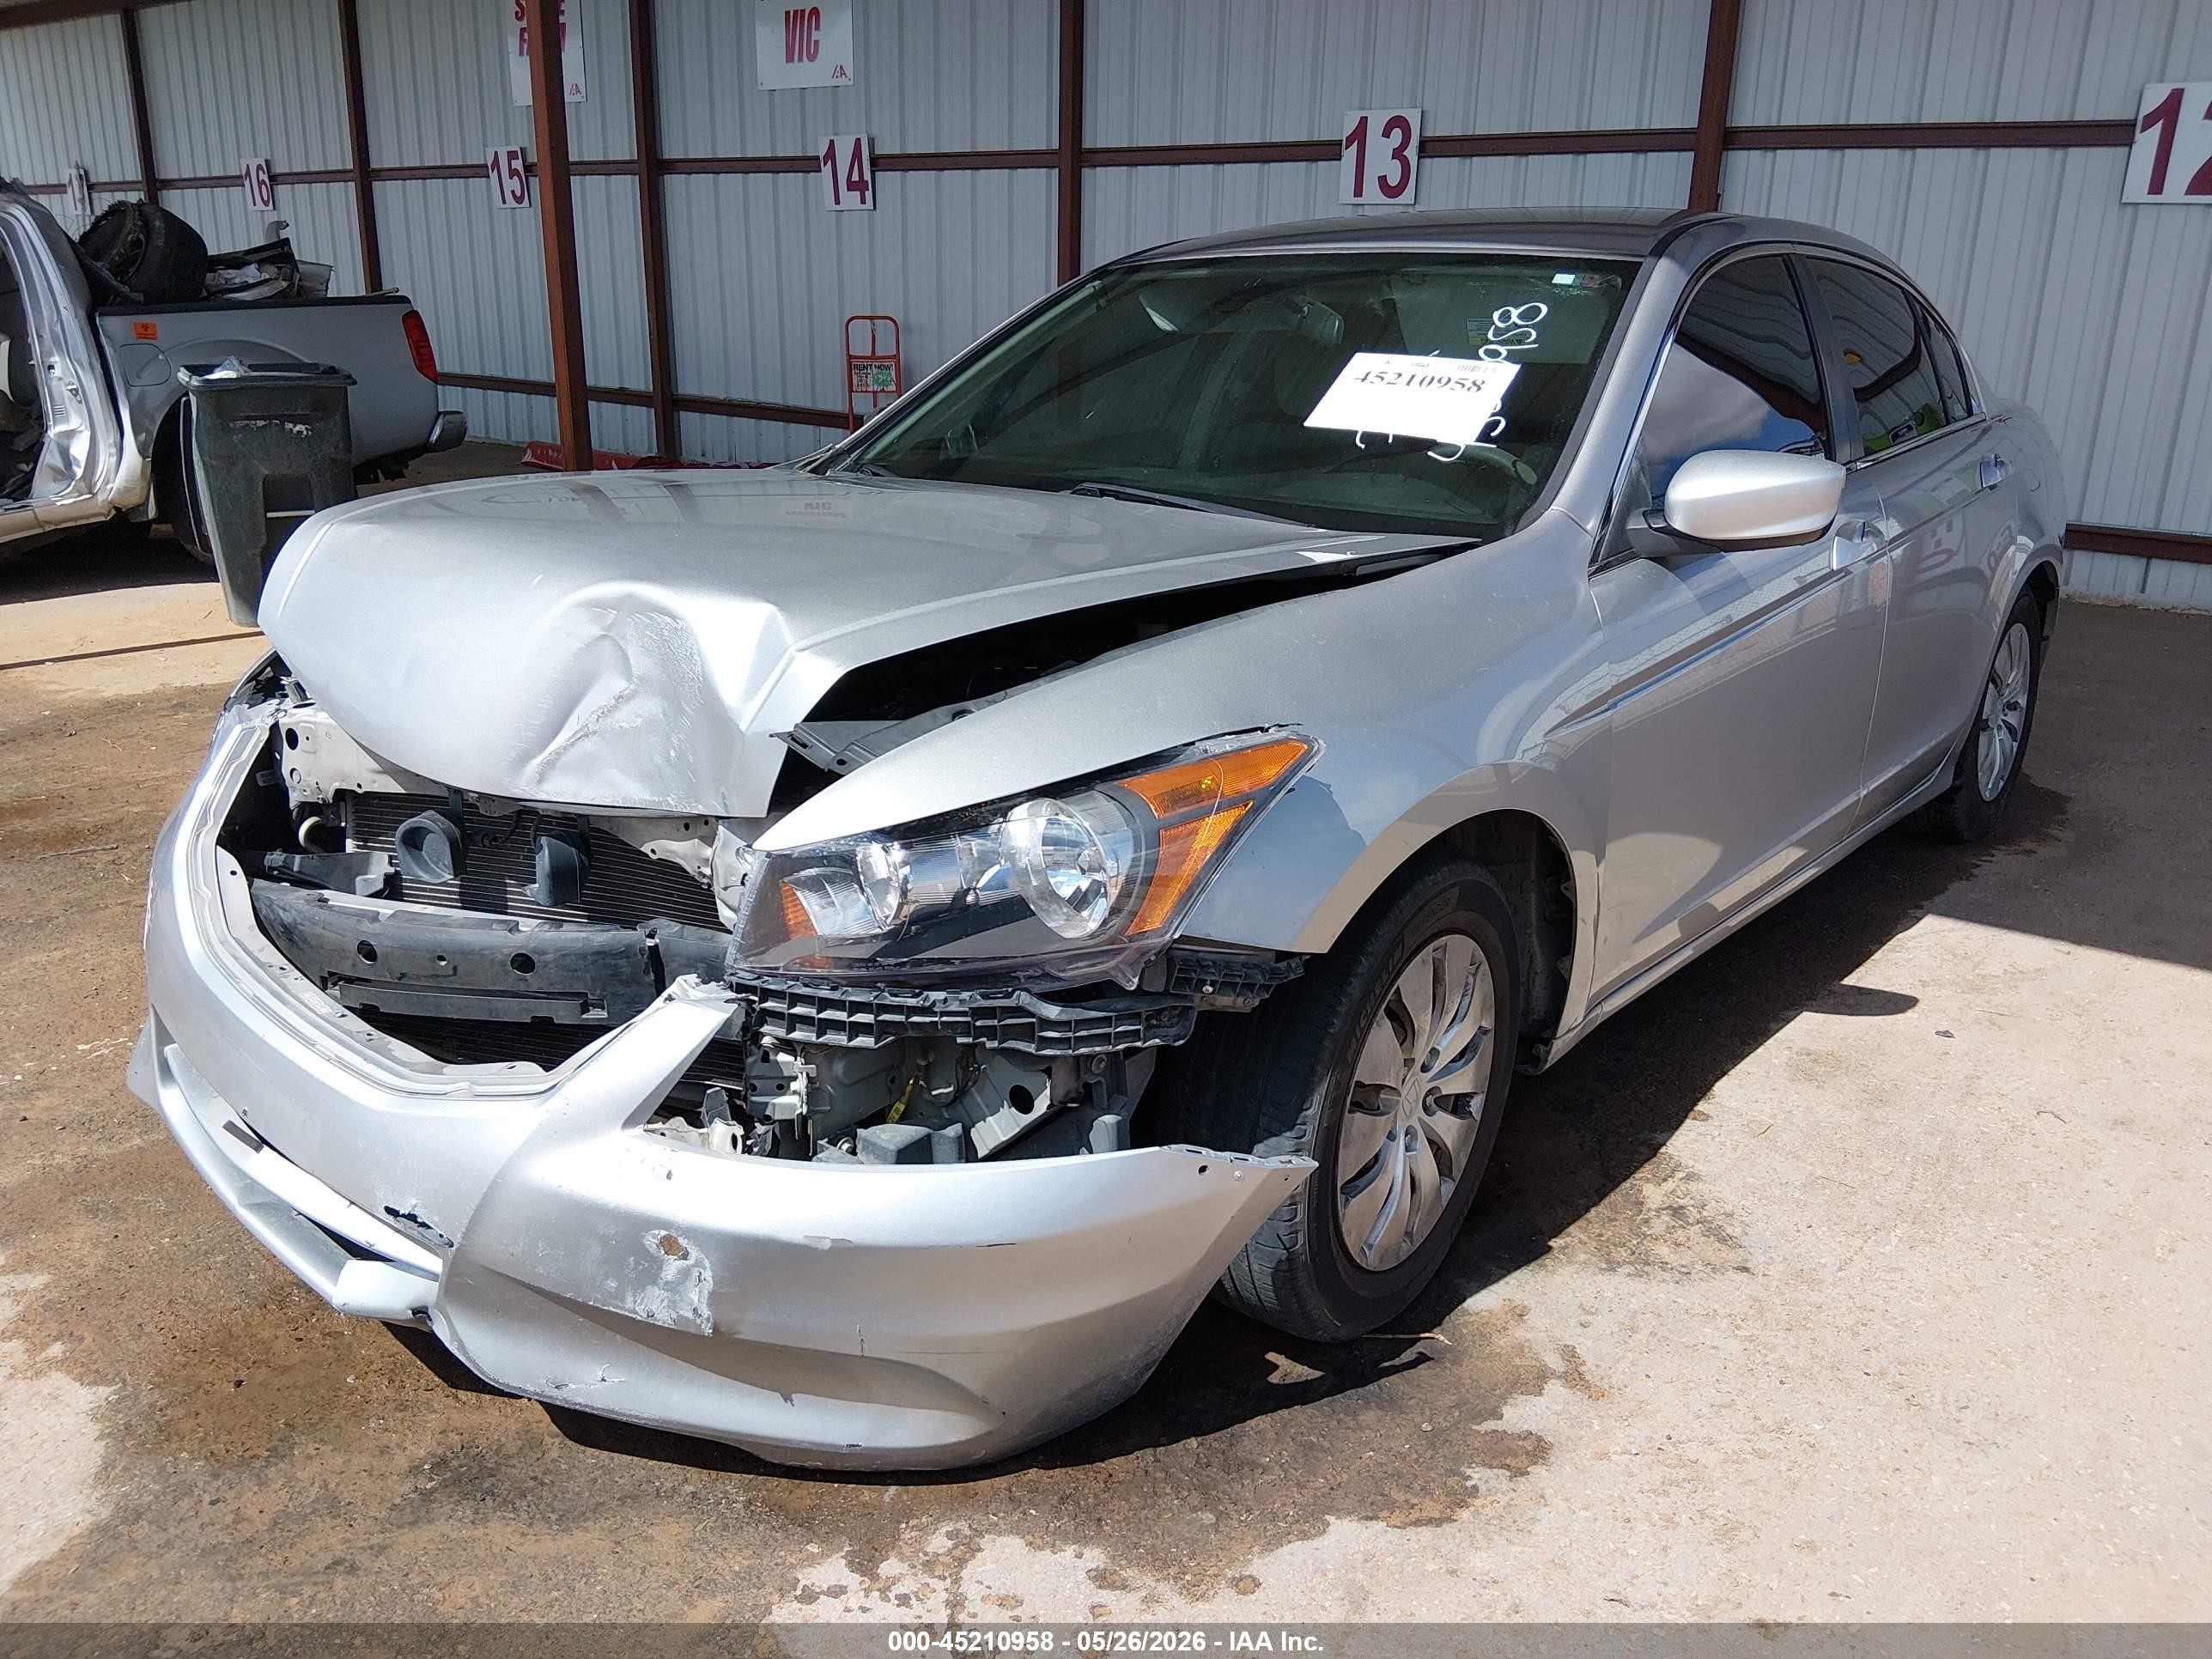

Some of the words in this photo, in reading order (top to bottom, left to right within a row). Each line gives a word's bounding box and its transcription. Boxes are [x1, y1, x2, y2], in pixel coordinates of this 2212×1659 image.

[785, 7, 821, 63] VIC
[490, 149, 526, 205] 15
[823, 137, 870, 205] 14
[1344, 114, 1413, 199] 13
[244, 163, 271, 207] 16
[853, 363, 872, 372] RENT
[874, 363, 894, 372] NOW!
[1355, 370, 1486, 392] 45210958
[1346, 942, 1403, 1064] MICHELIN
